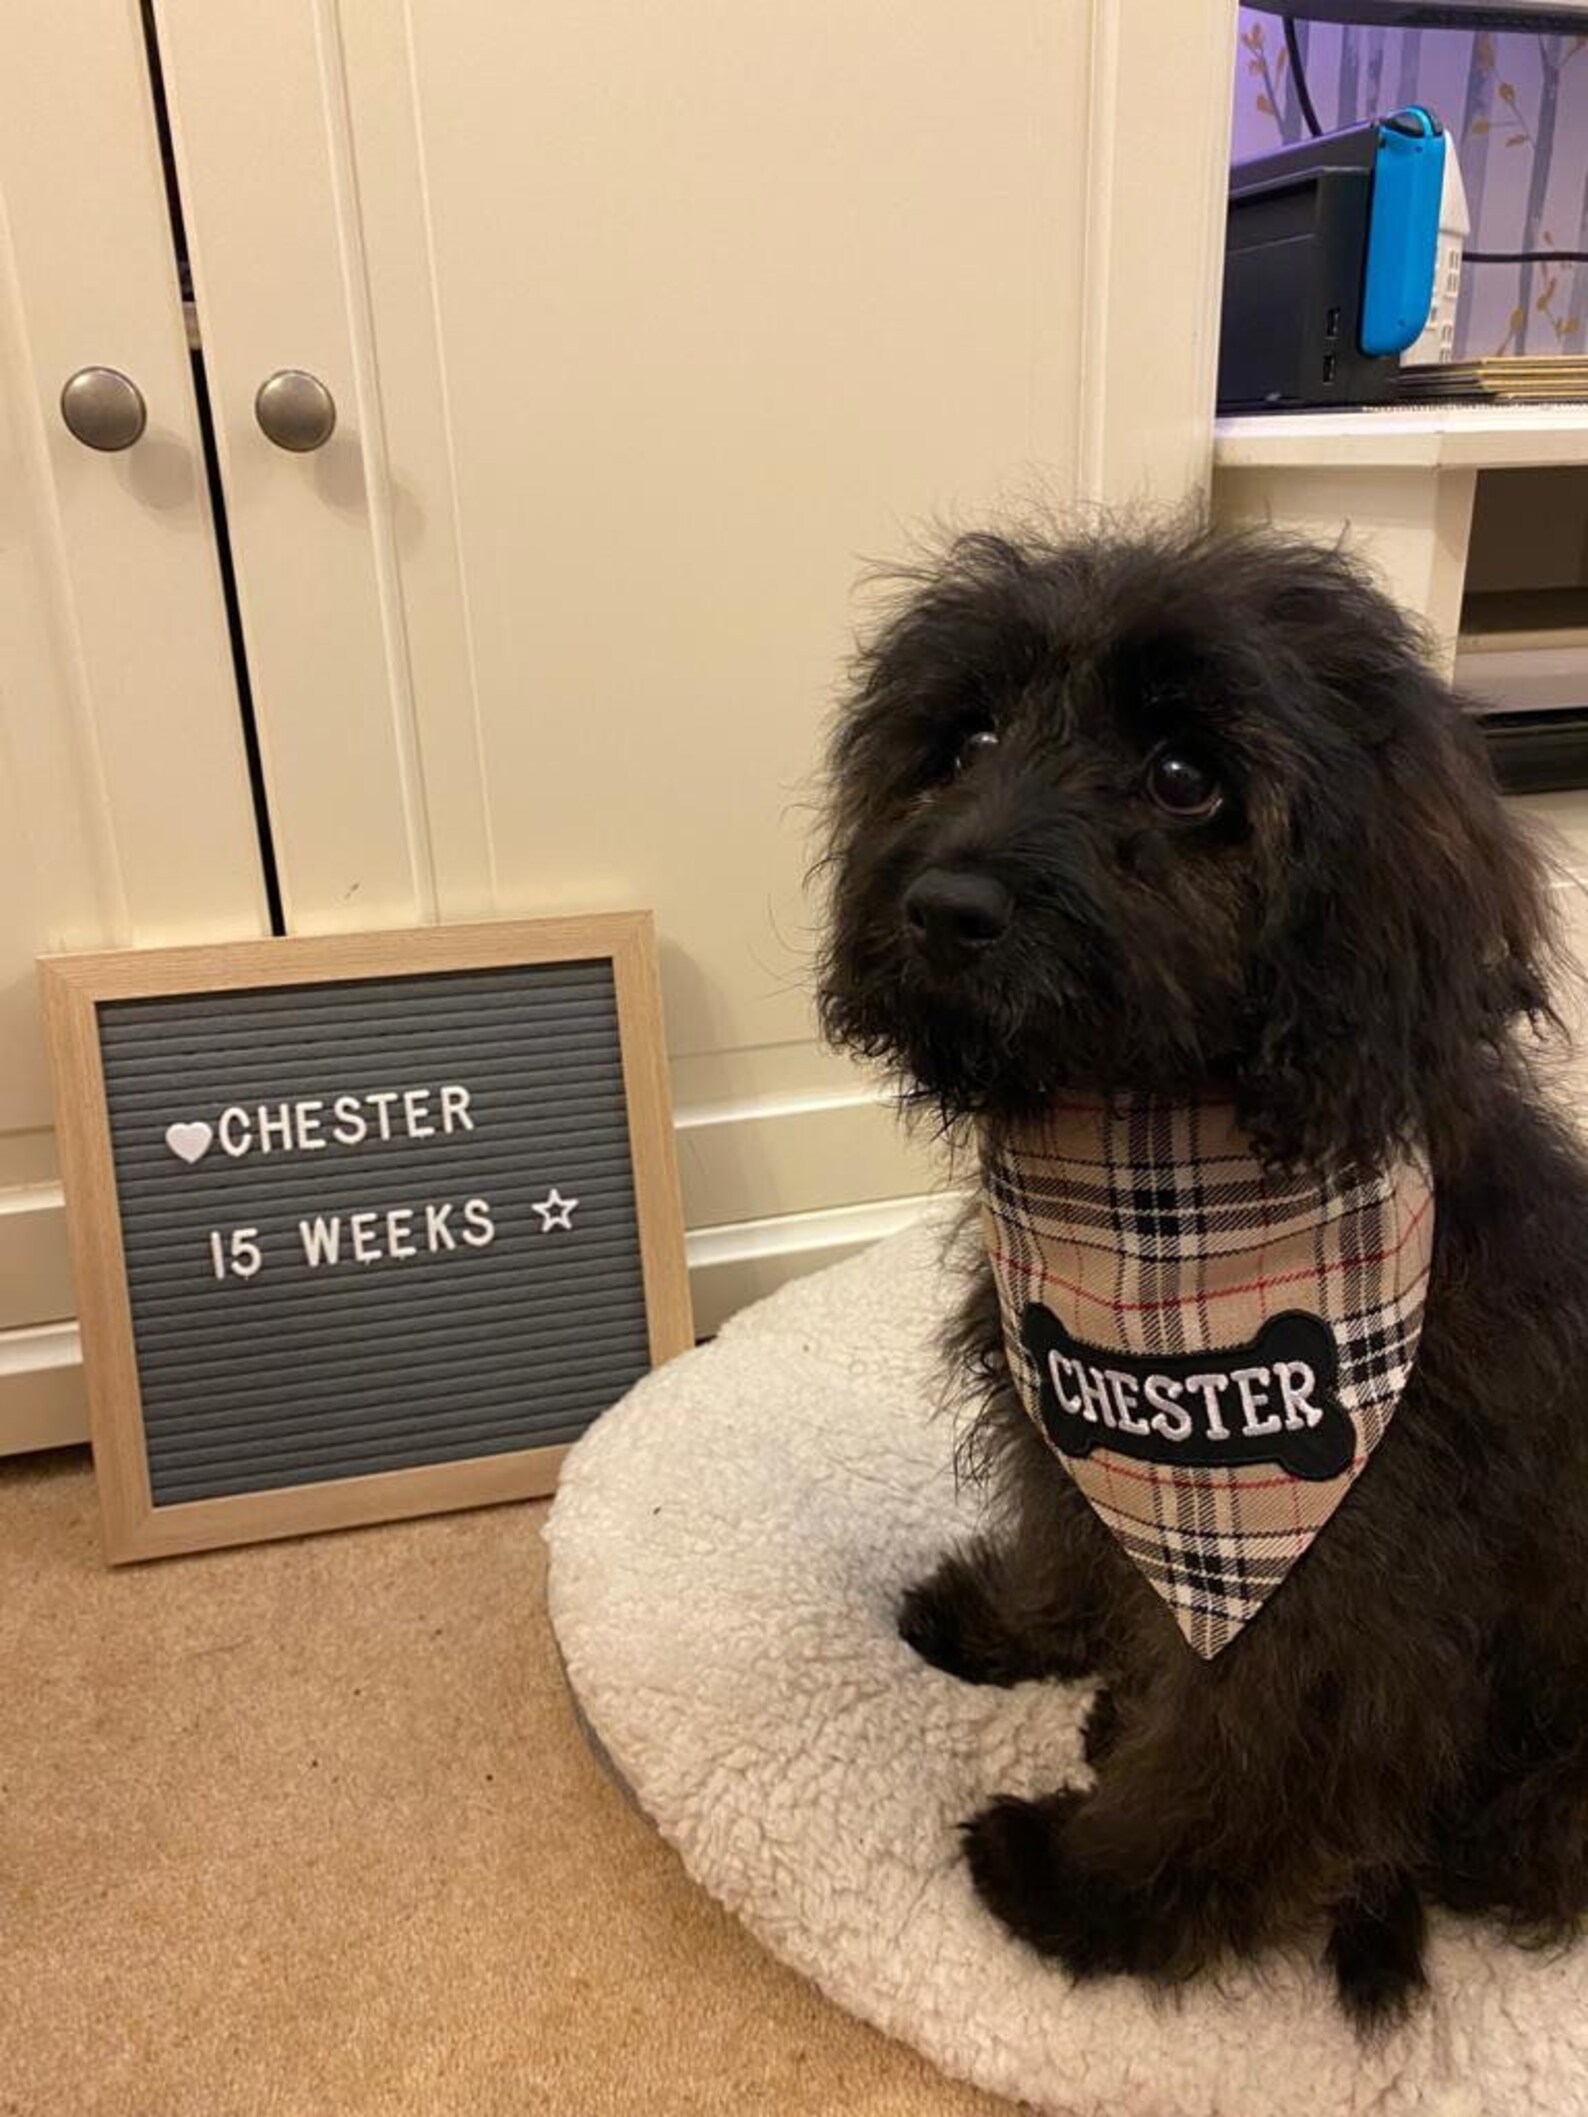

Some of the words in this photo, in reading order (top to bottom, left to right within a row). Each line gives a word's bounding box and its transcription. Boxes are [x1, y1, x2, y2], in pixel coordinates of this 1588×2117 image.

[218, 1085, 475, 1158] CHESTER
[210, 1227, 263, 1280] 15
[299, 1198, 497, 1268] WEEKS
[1047, 1348, 1324, 1442] CHESTER
